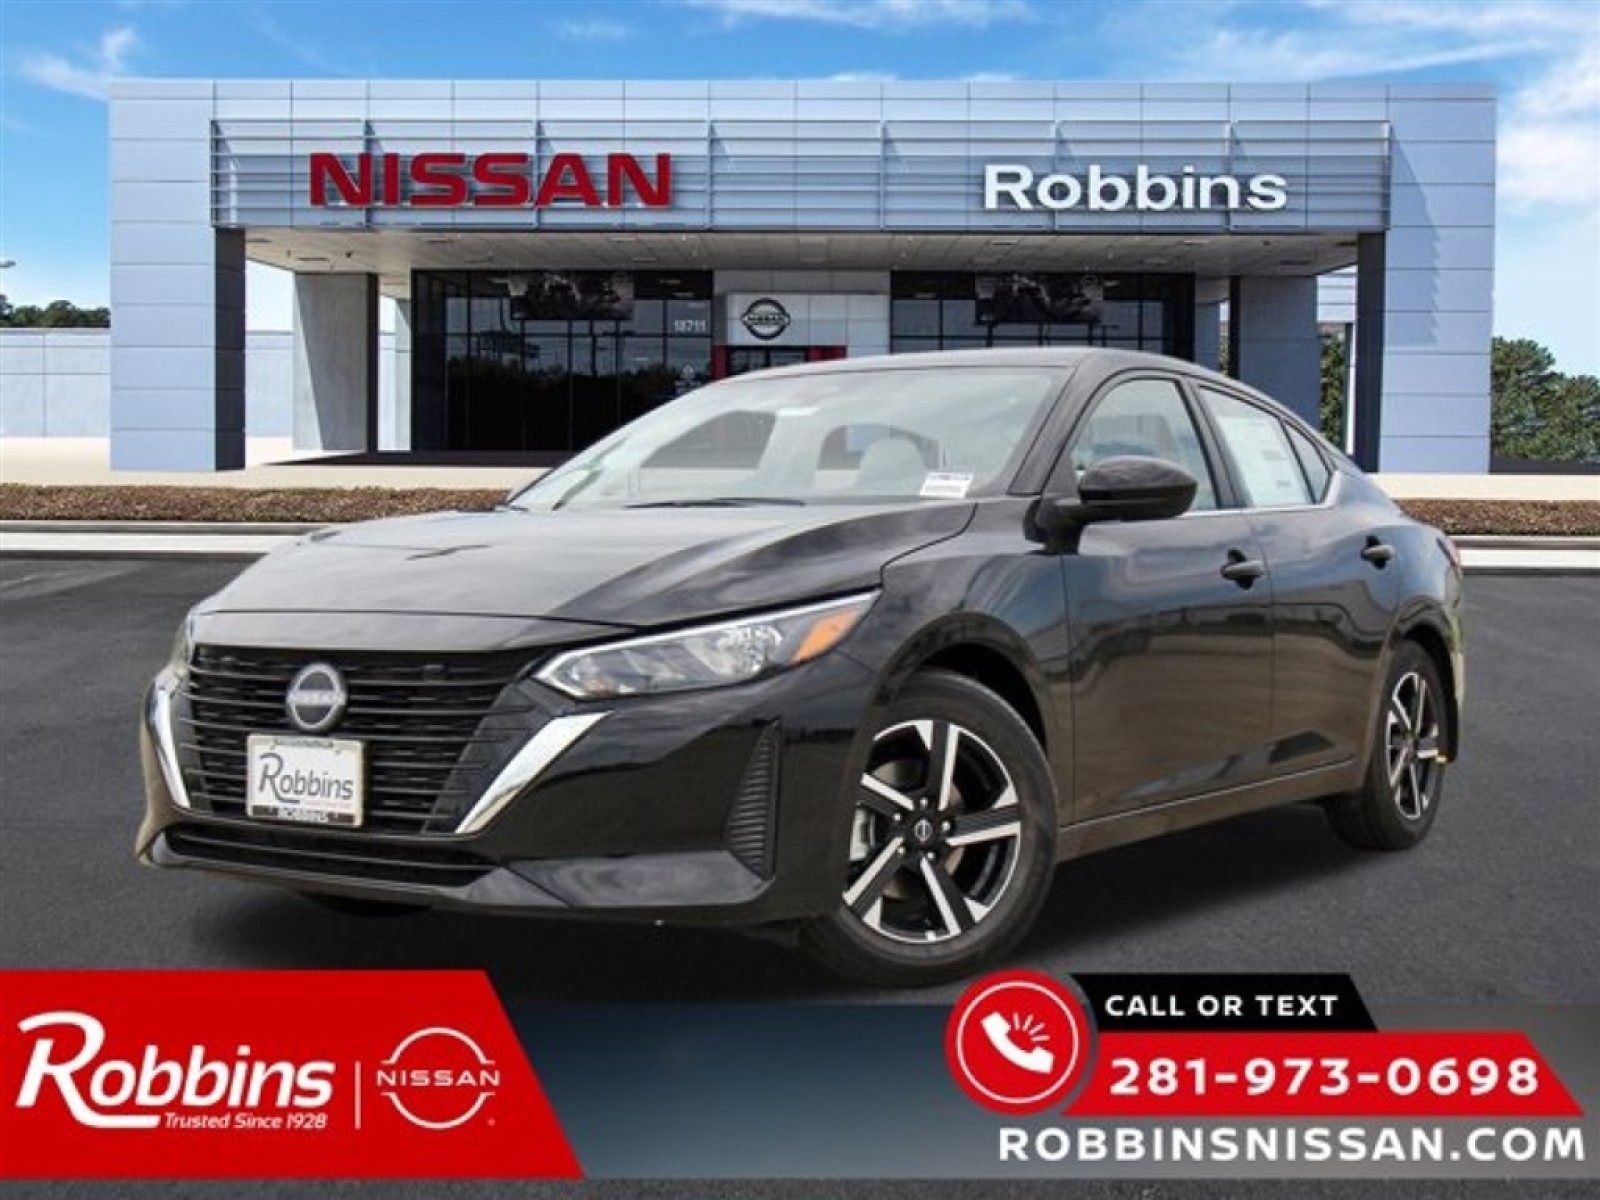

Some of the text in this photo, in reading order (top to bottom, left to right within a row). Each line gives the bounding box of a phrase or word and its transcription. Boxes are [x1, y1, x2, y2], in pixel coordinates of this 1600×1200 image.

[310, 152, 671, 207] NISSAN
[984, 164, 1287, 211] Robbins
[258, 752, 354, 804] Robbins
